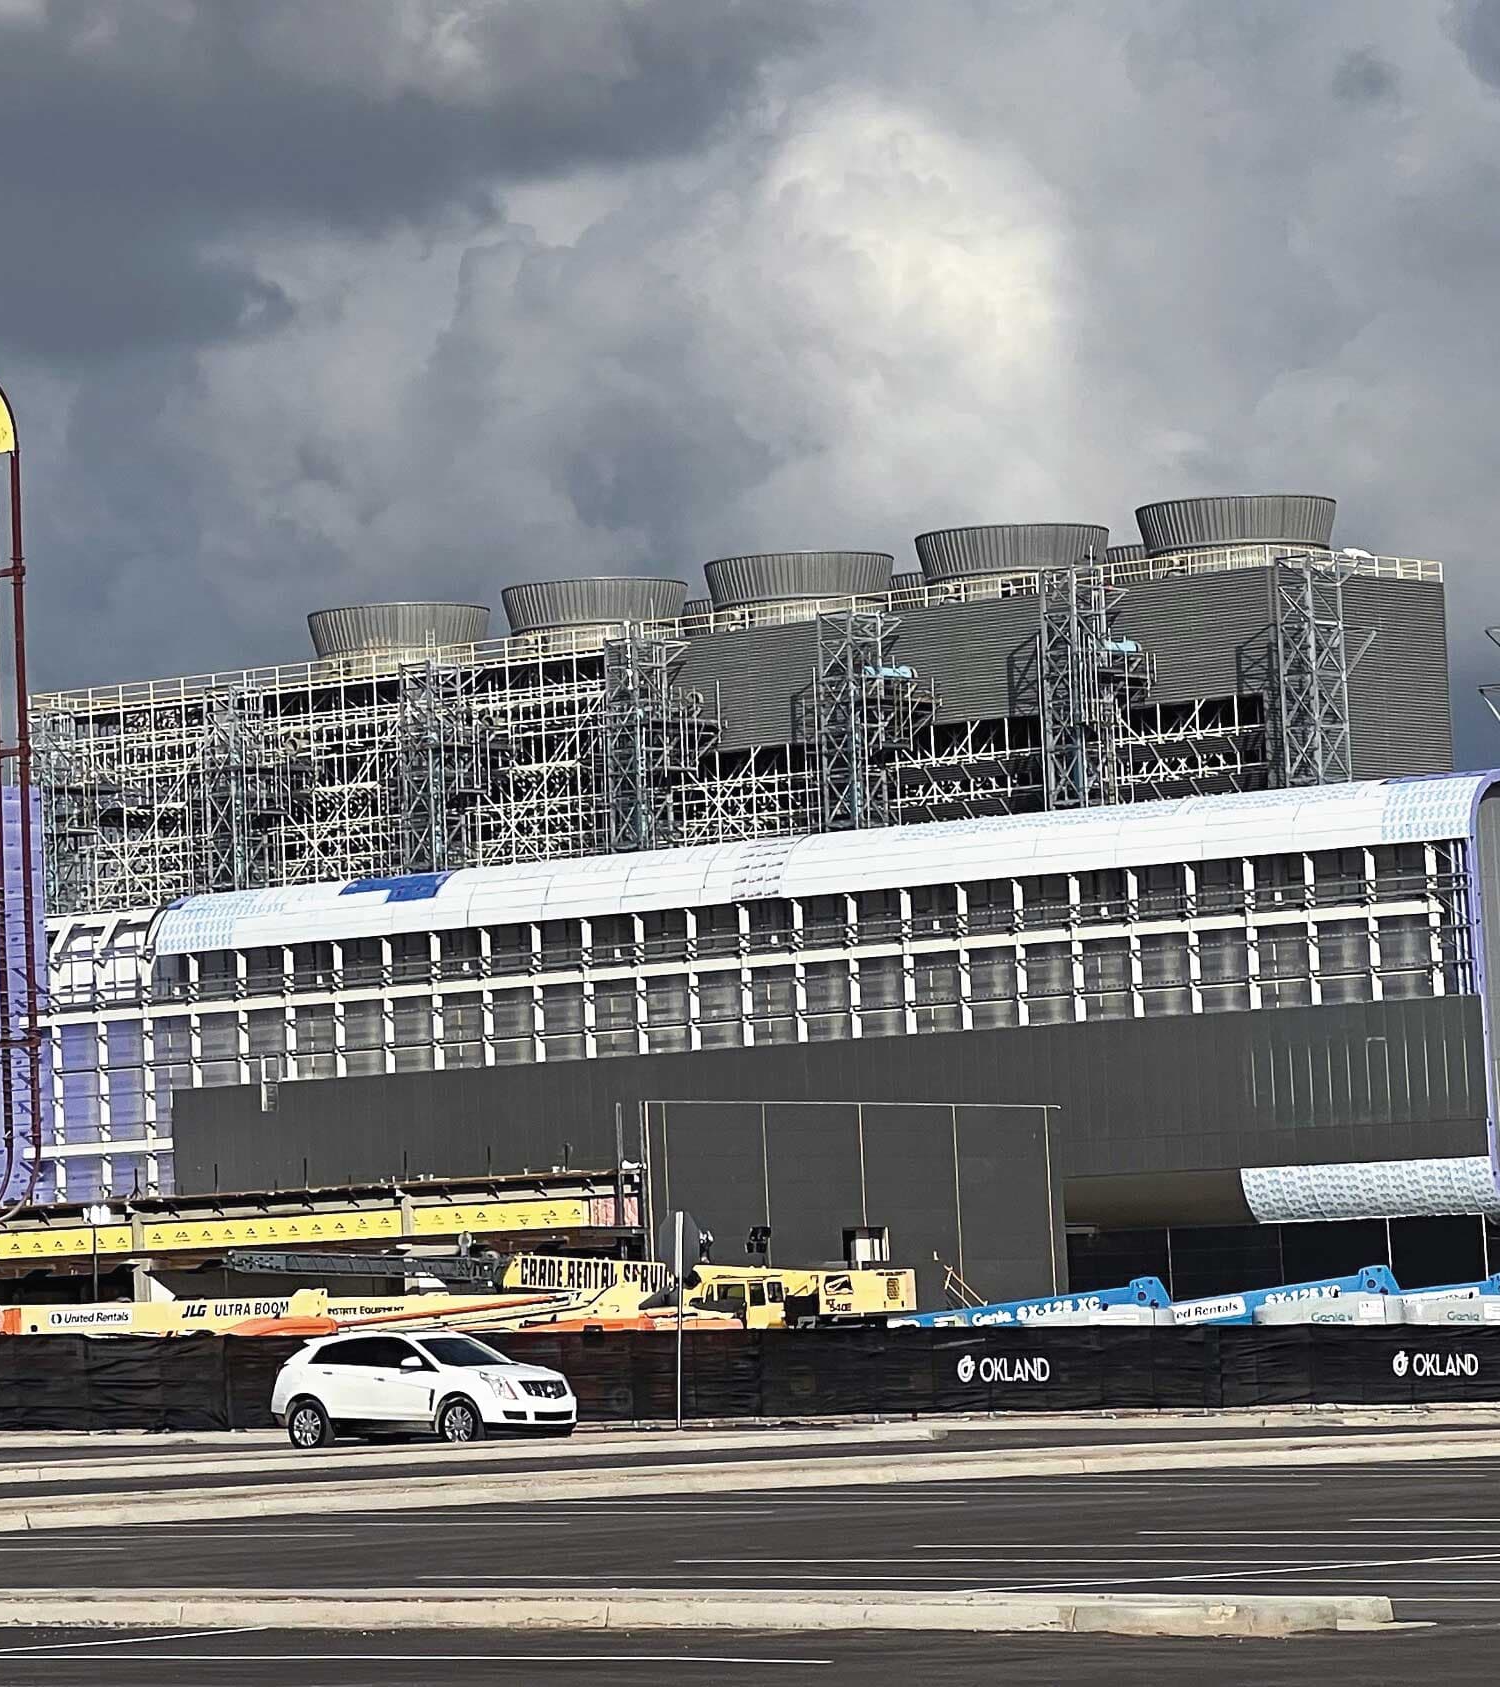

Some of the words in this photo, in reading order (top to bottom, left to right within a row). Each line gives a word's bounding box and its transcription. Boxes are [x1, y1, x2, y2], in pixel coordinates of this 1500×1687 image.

[64, 1312, 94, 1323] United
[96, 1311, 129, 1322] Rentals
[182, 1304, 207, 1318] JLG
[214, 1303, 251, 1317] ULTRA
[254, 1301, 289, 1316] BOOM
[1195, 1302, 1239, 1316] Rentals
[980, 1357, 1050, 1382] OKLAND
[1412, 1353, 1479, 1376] OKLAND
